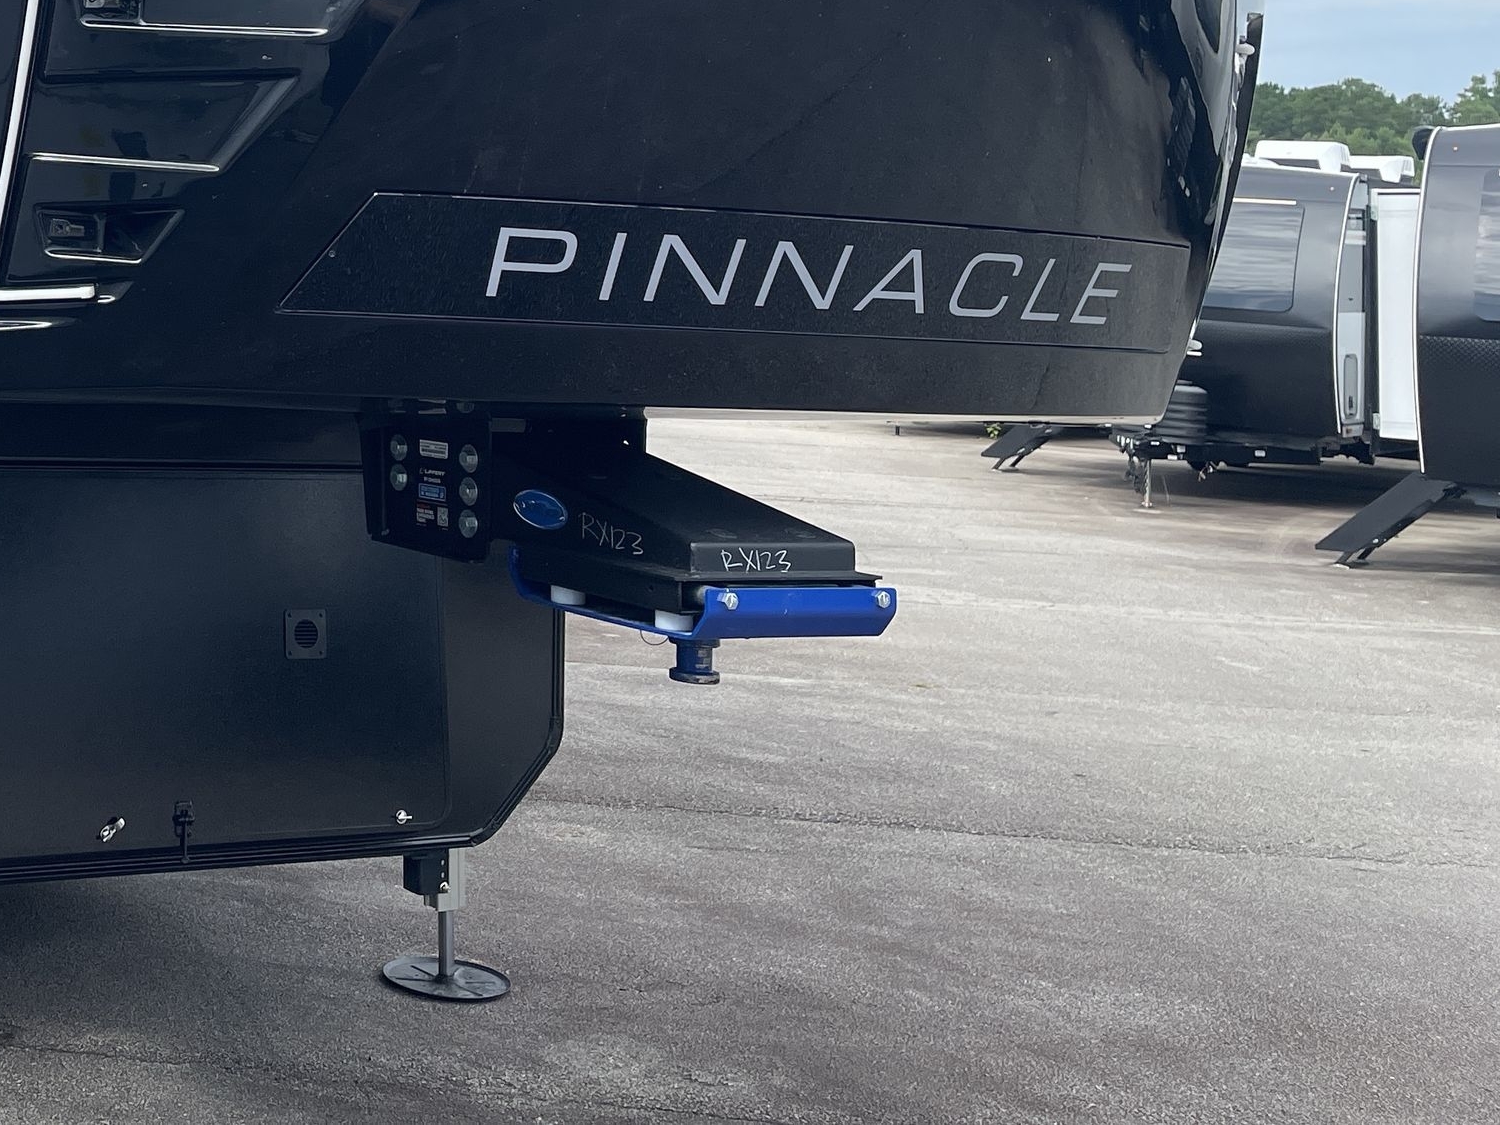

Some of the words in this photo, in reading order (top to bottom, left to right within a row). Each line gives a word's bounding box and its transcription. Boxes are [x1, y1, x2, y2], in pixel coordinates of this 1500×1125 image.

[484, 226, 1133, 325] PINNACLE
[579, 511, 644, 555] RX123
[720, 547, 792, 574] RX123
